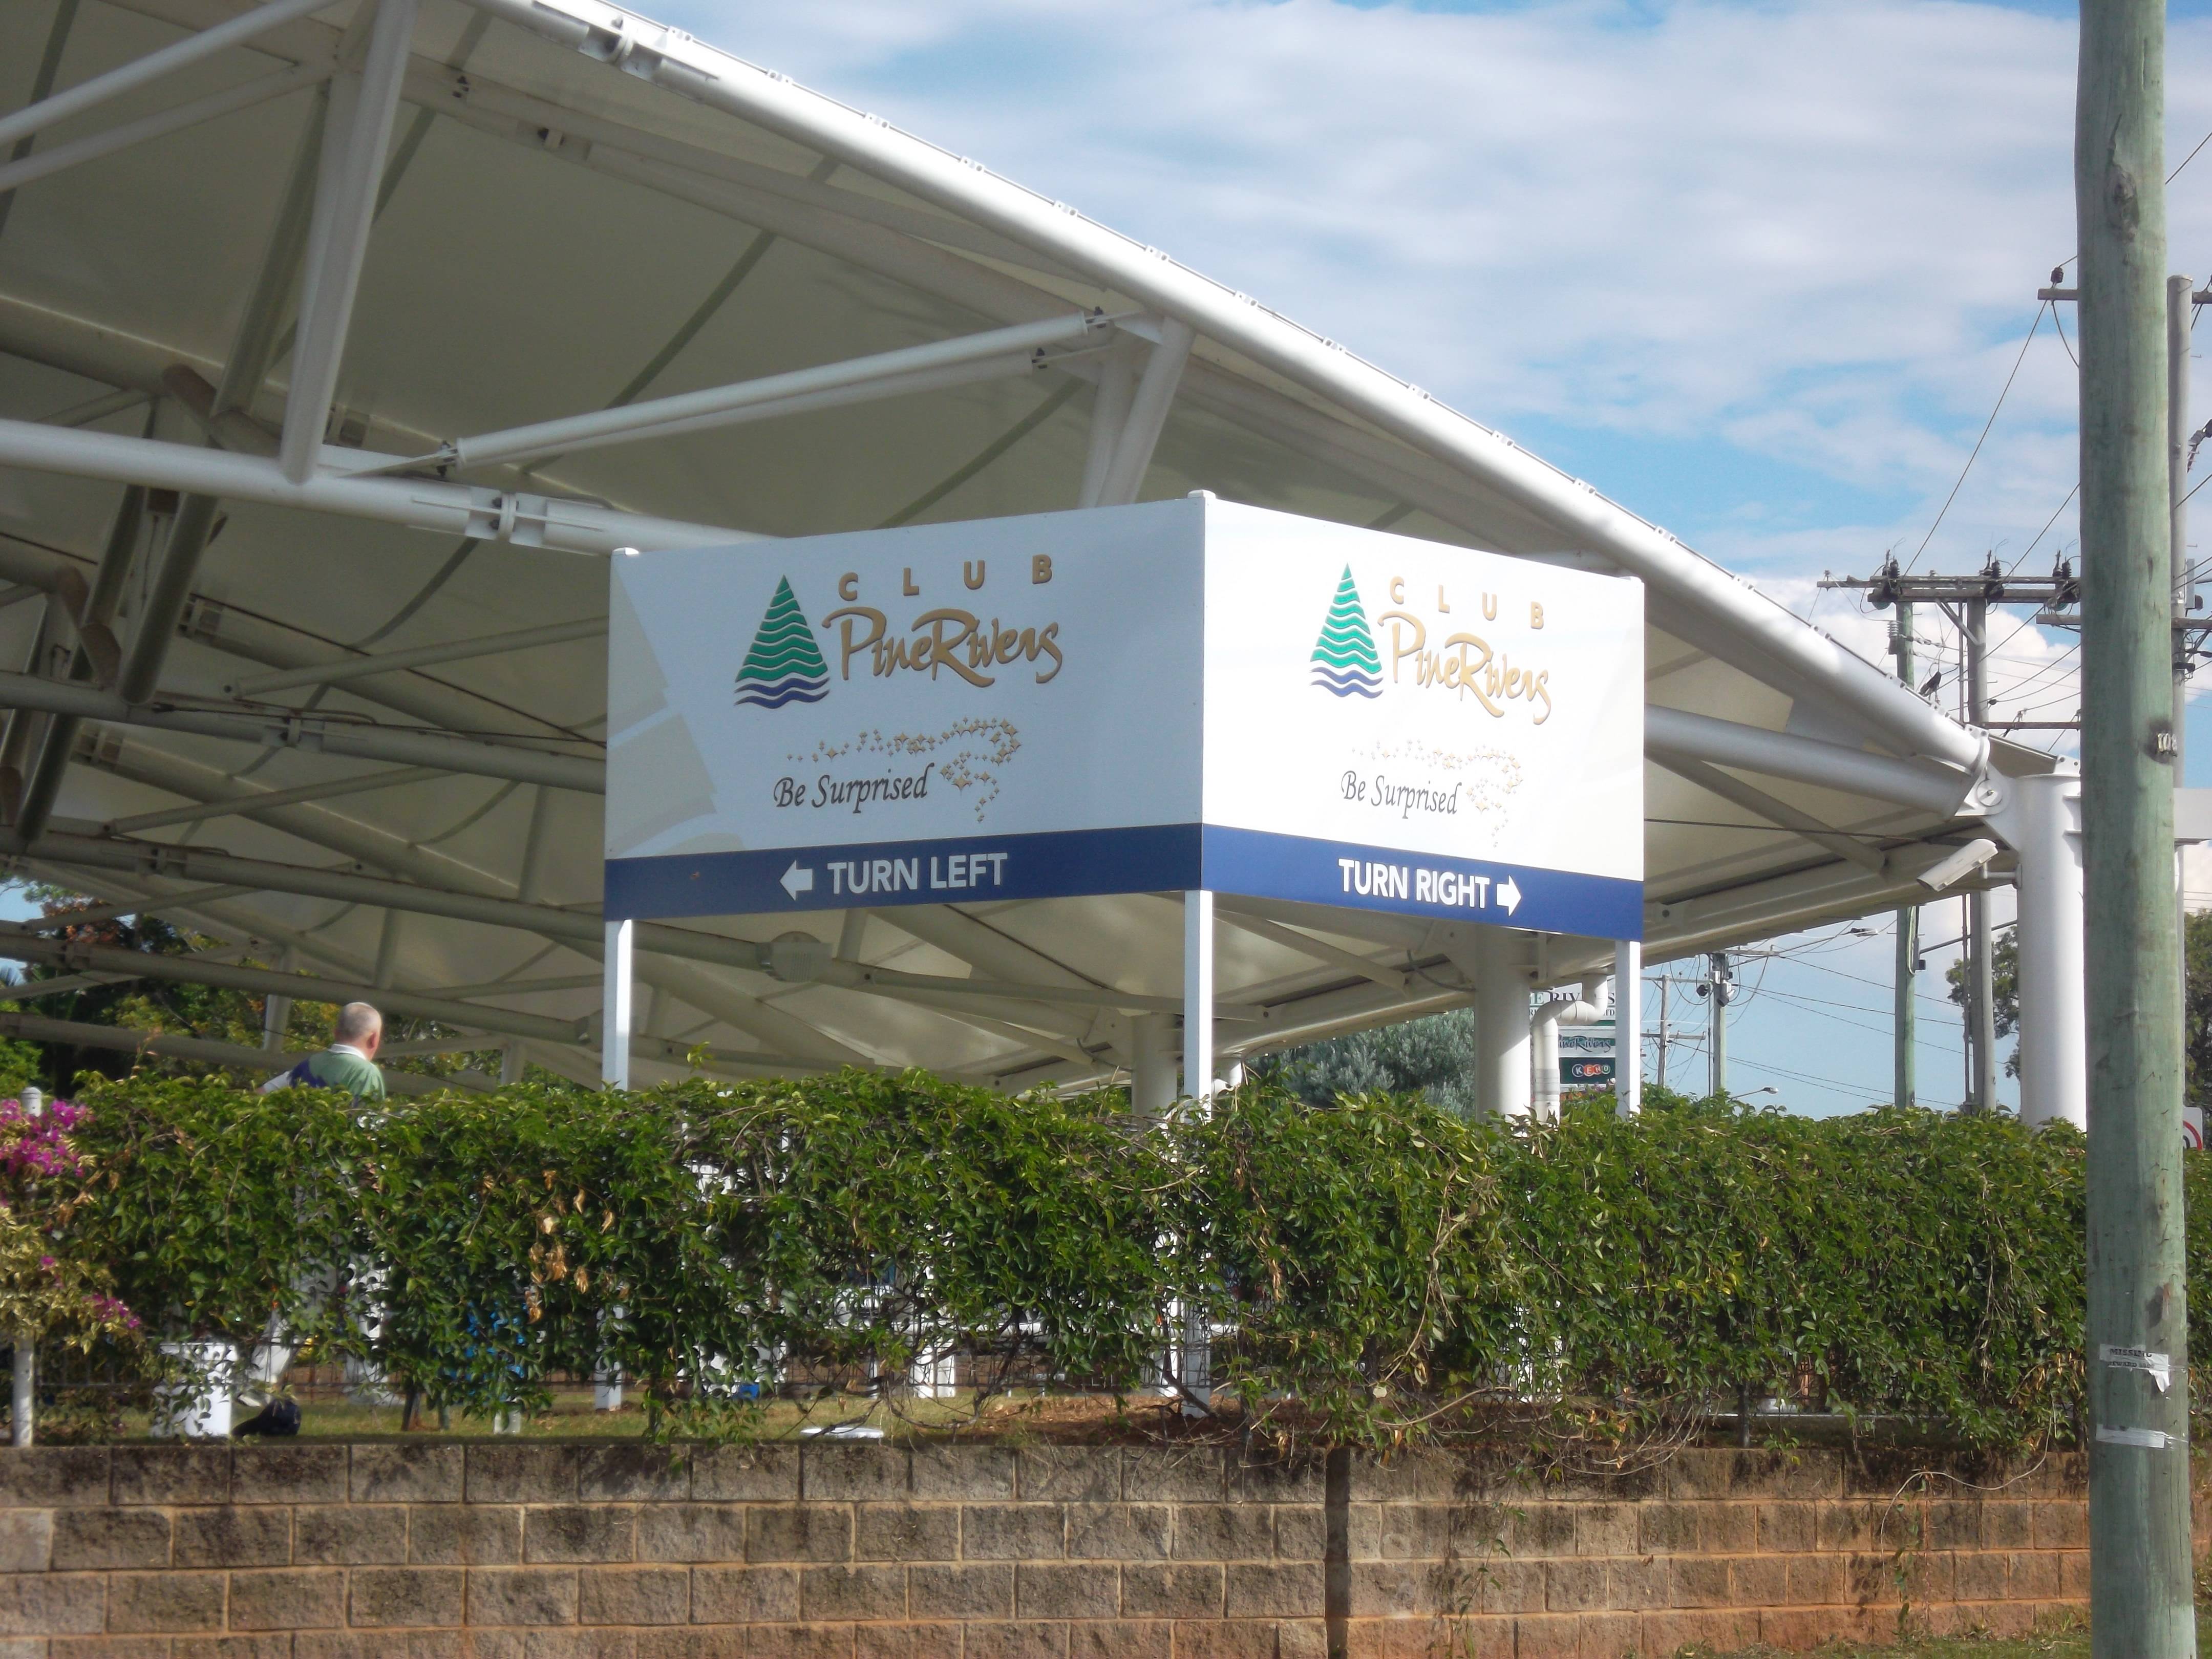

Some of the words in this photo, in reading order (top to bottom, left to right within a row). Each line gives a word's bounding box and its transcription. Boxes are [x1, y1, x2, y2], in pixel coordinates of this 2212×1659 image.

[838, 554, 1052, 602] CLUB
[1389, 576, 1544, 630] CLUB
[821, 606, 1063, 688] PineRivers
[1377, 610, 1551, 726] PineRivers
[773, 776, 804, 807] Be
[811, 762, 935, 814] Surprised
[1341, 770, 1365, 802] Be
[1370, 774, 1462, 820] Surprised
[827, 858, 918, 895] TURN
[930, 853, 1008, 890] LEFT
[1338, 859, 1408, 900] TURN
[1416, 869, 1491, 909] RIGHT
[1549, 992, 1615, 1005] RIVS
[1573, 1065, 1609, 1075] KENO
